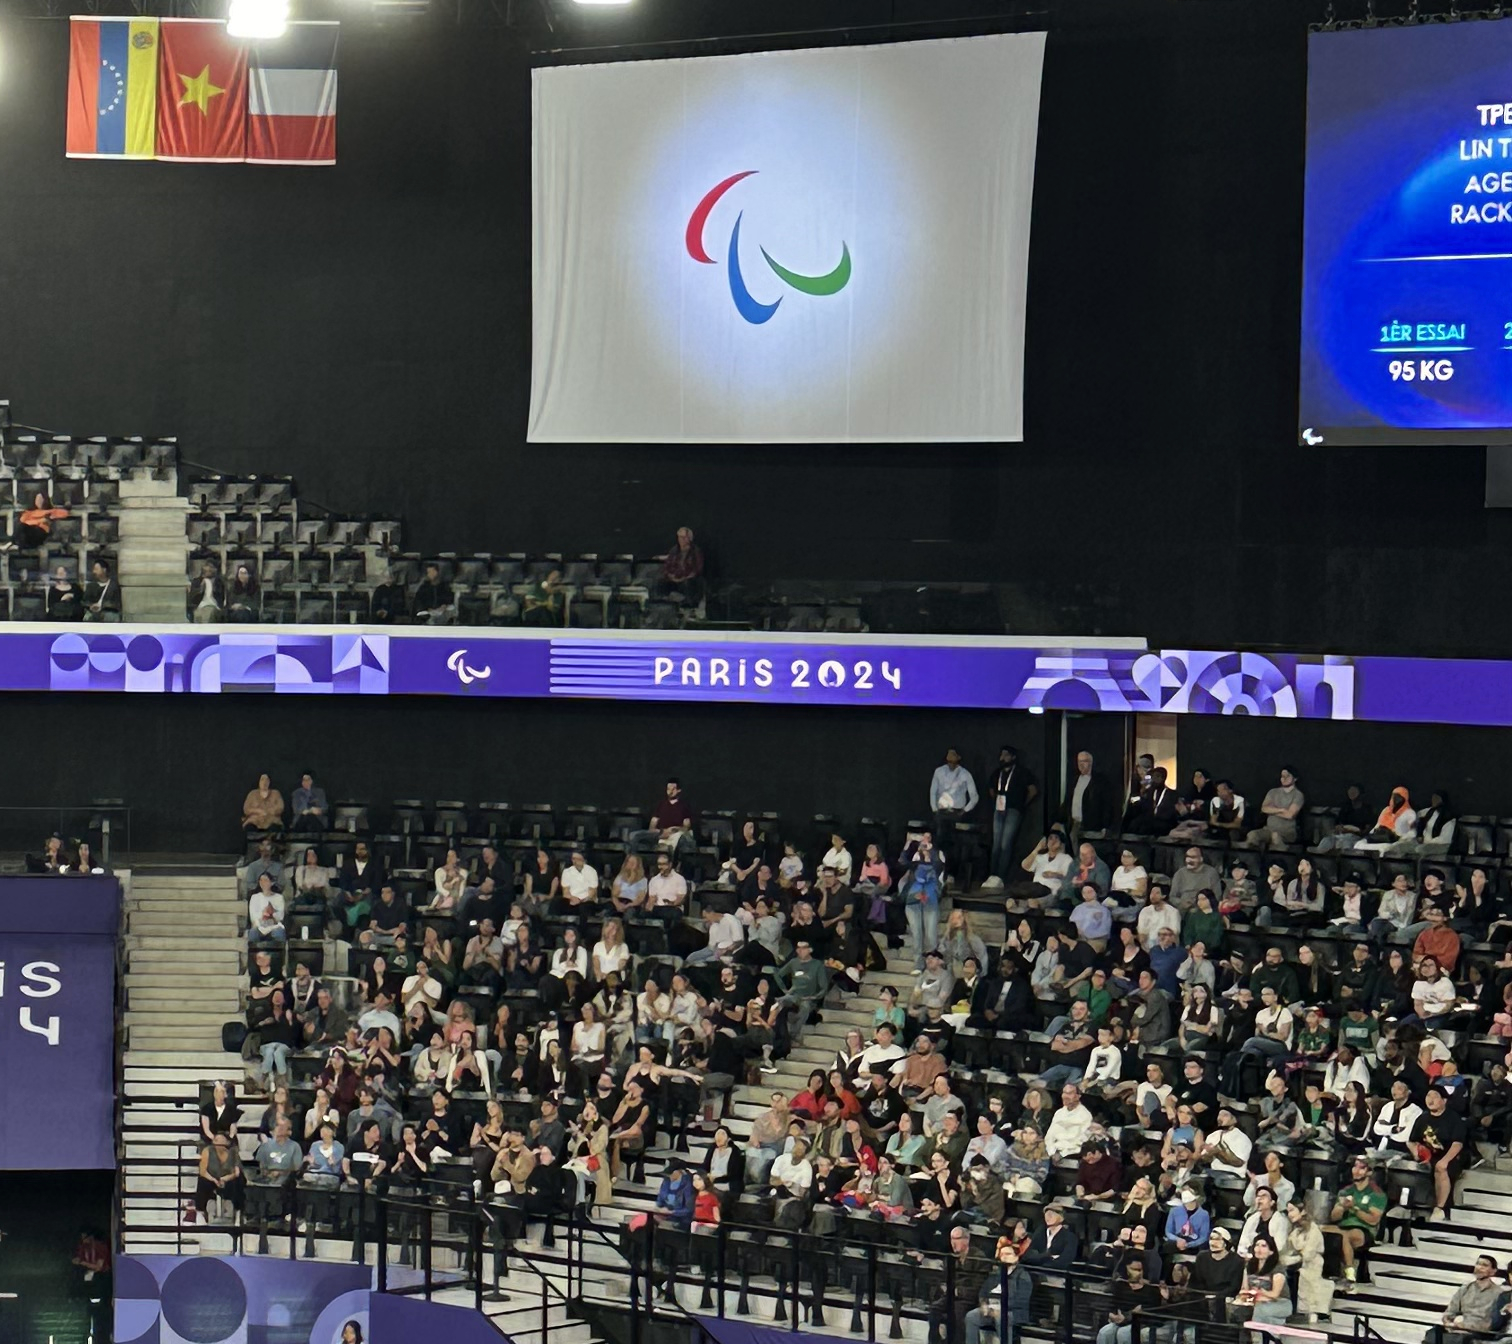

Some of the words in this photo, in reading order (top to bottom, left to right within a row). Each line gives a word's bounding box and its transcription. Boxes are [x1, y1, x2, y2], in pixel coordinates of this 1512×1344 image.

[1460, 138, 1493, 160] LIN
[1451, 202, 1512, 224] RACK
[1417, 323, 1465, 341] ESSAI
[1389, 360, 1416, 381] 95
[1420, 360, 1454, 381] KG
[654, 657, 773, 687] PARIS
[791, 659, 901, 690] 2024
